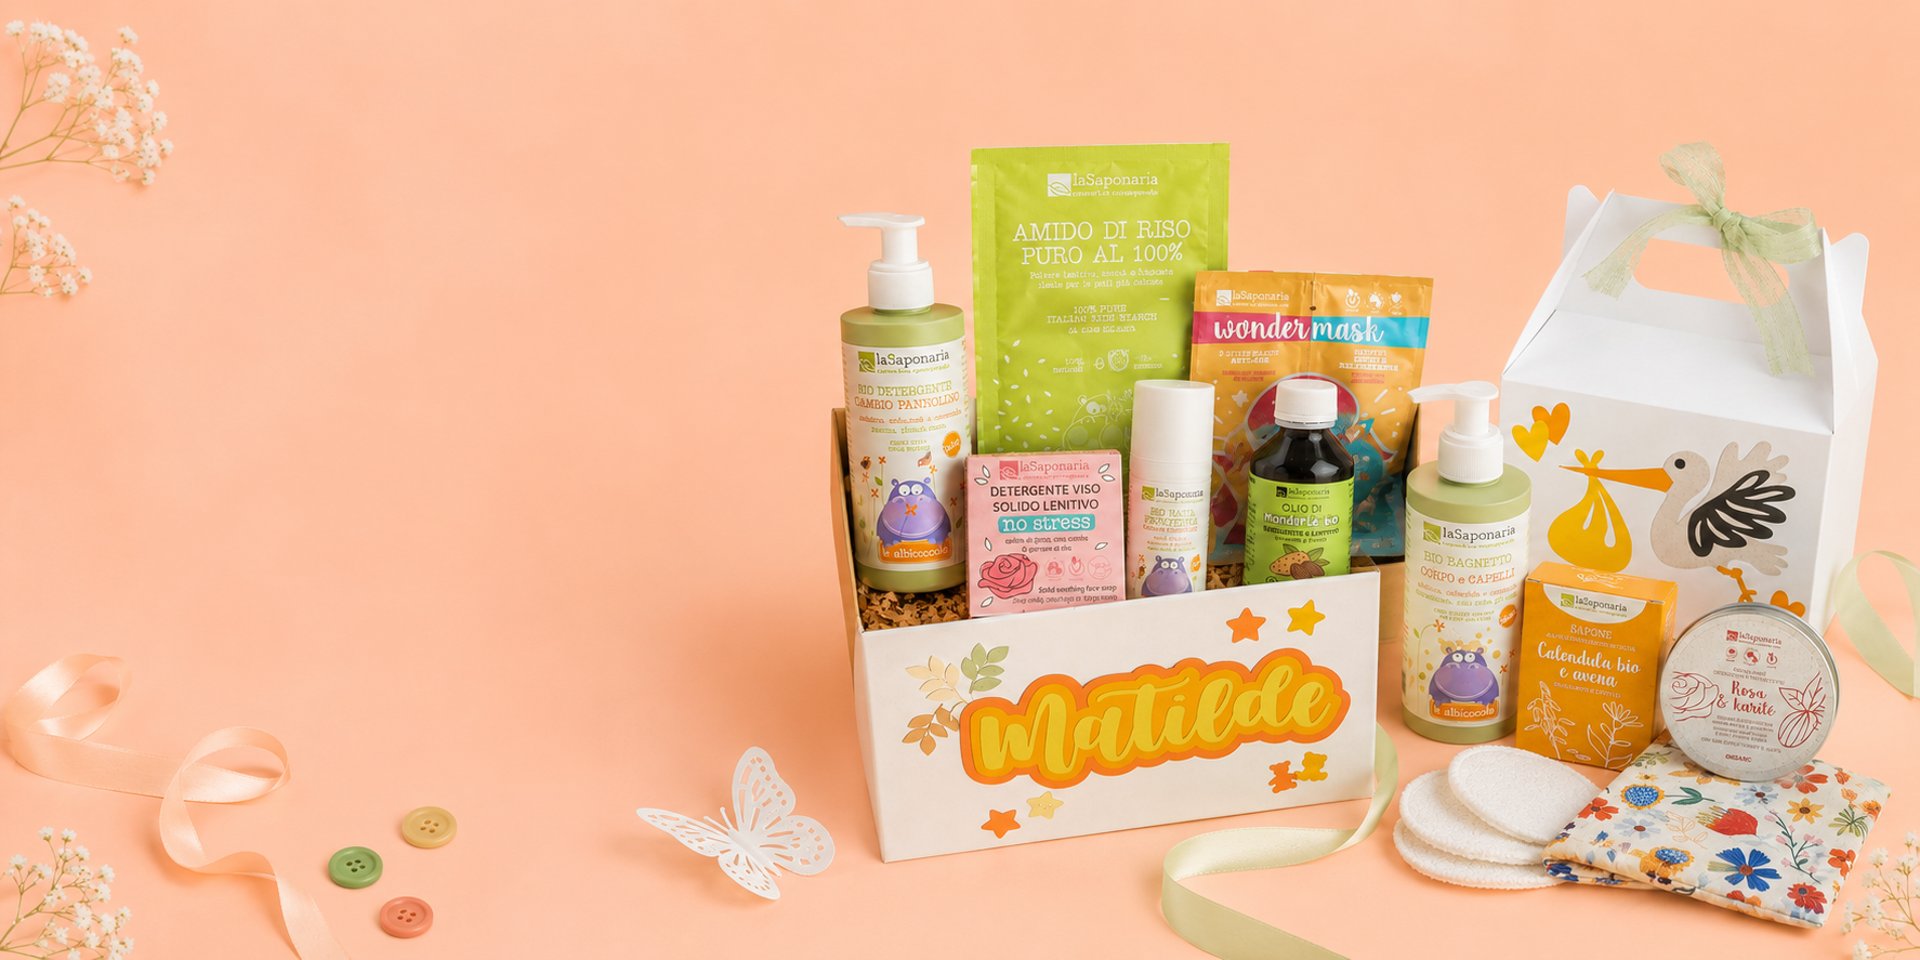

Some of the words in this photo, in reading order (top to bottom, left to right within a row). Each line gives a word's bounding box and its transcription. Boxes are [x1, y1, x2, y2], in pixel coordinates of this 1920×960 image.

[1073, 172, 1159, 189] laSaponaria
[1013, 222, 1093, 241] AMIDO
[1103, 220, 1127, 240] DI
[1136, 219, 1191, 239] RISO
[1021, 246, 1082, 265] PURO
[1093, 244, 1124, 263] AL
[1134, 242, 1183, 262] 100%
[1214, 311, 1310, 340] wonder
[1312, 315, 1384, 343] mask
[876, 349, 950, 368] laSaponaria
[854, 396, 894, 410] CAMBIO
[1020, 460, 1090, 474] laSaponaria
[990, 484, 1069, 497] DETERGENTE
[1073, 483, 1101, 495] VISO
[992, 500, 1040, 513] SOLIDO
[1043, 499, 1099, 511] LENITIVO
[1282, 503, 1309, 513] OLIO
[1312, 503, 1322, 513] DI
[1002, 519, 1027, 531] no
[1033, 516, 1091, 531] stress
[1443, 525, 1516, 543] laSaponaria
[1424, 550, 1443, 565] BIO
[1446, 553, 1512, 569] BAGNETTO
[1468, 567, 1515, 584] CAPELLI
[1570, 624, 1613, 640] SAPONE
[1538, 641, 1614, 671] Calendula
[1617, 657, 1640, 674] bio
[1560, 667, 1568, 678] e
[1573, 670, 1618, 688] avena
[1731, 680, 1767, 699] Rosa
[1717, 693, 1728, 708] &
[981, 664, 1332, 775] Matilde
